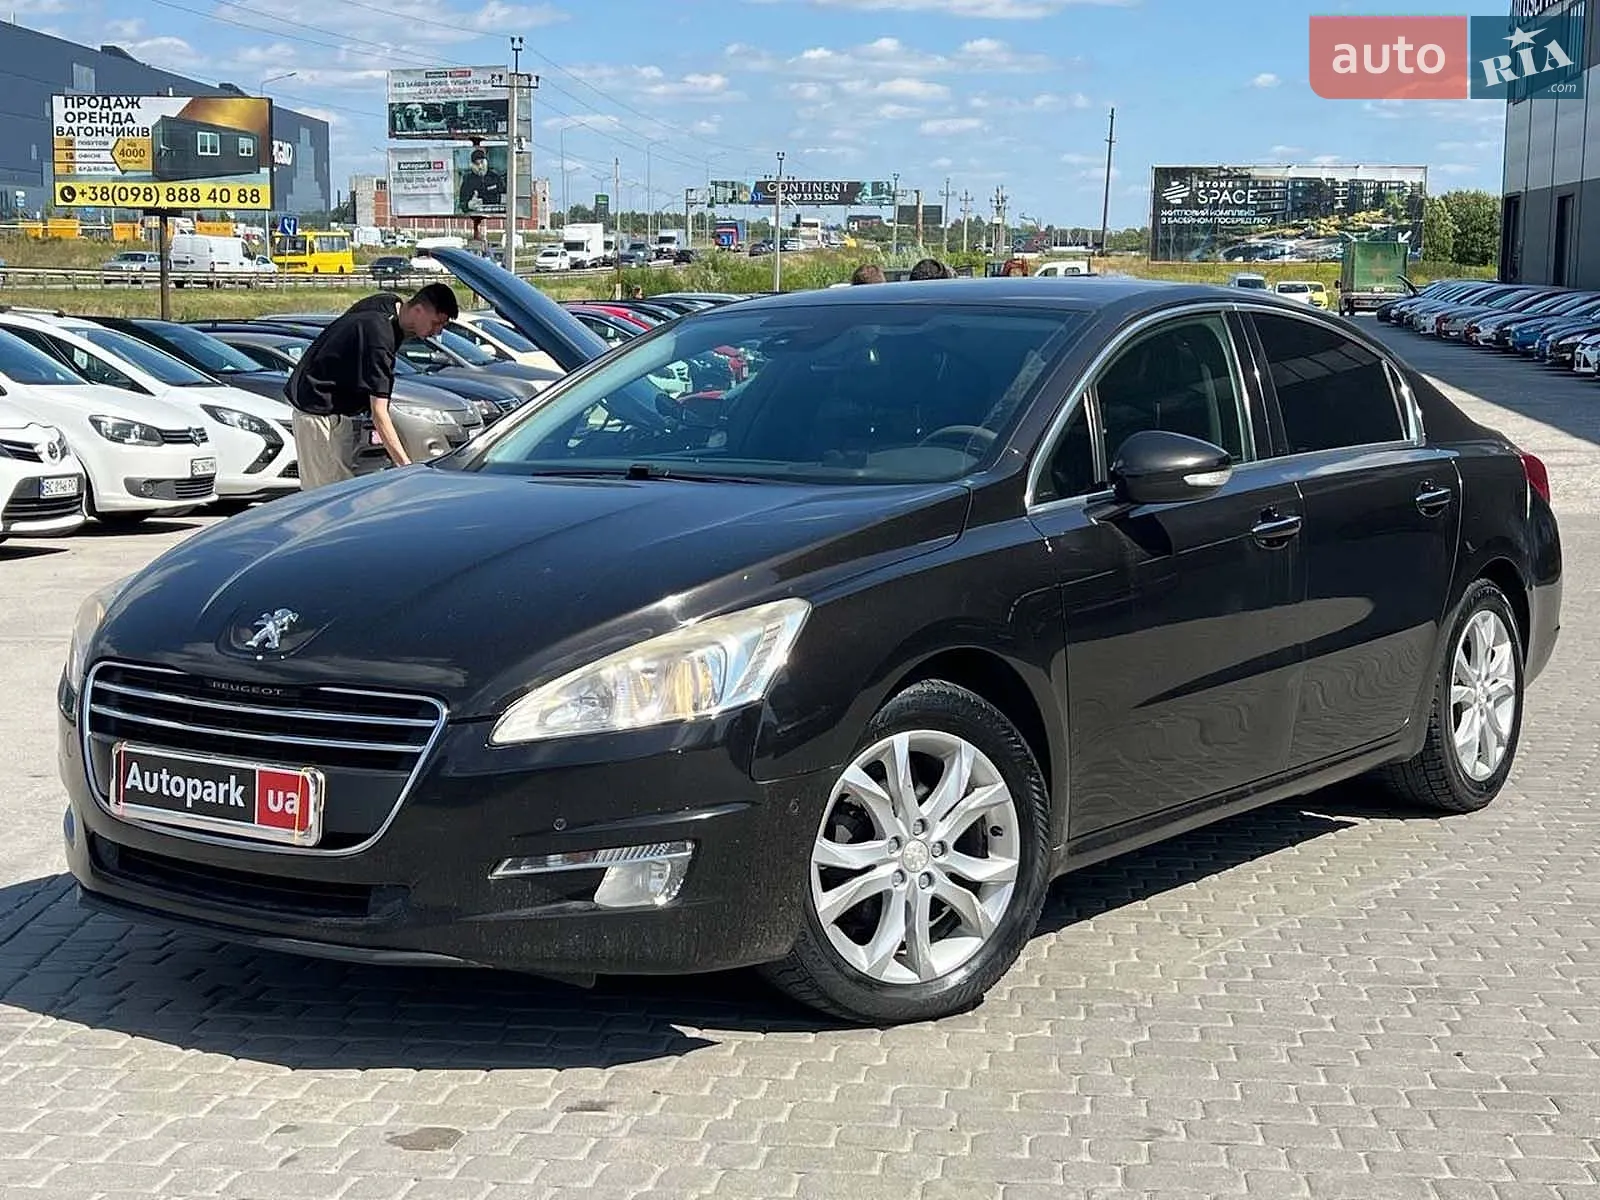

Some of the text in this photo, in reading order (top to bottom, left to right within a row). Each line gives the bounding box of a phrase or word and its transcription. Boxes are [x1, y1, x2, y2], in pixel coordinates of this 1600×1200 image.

[64, 97, 141, 110] ПРОДАЖ
[64, 111, 136, 124] ОРЕНДА
[56, 126, 150, 137] ВАГОНЧИКІВ
[119, 149, 146, 157] 4000
[767, 182, 849, 193] CONTINENT
[79, 186, 261, 205] +38(098) 888 40 88
[1198, 189, 1258, 204] SPACE
[212, 681, 283, 696] PEUGEOT
[125, 762, 300, 815] Autopark ua
